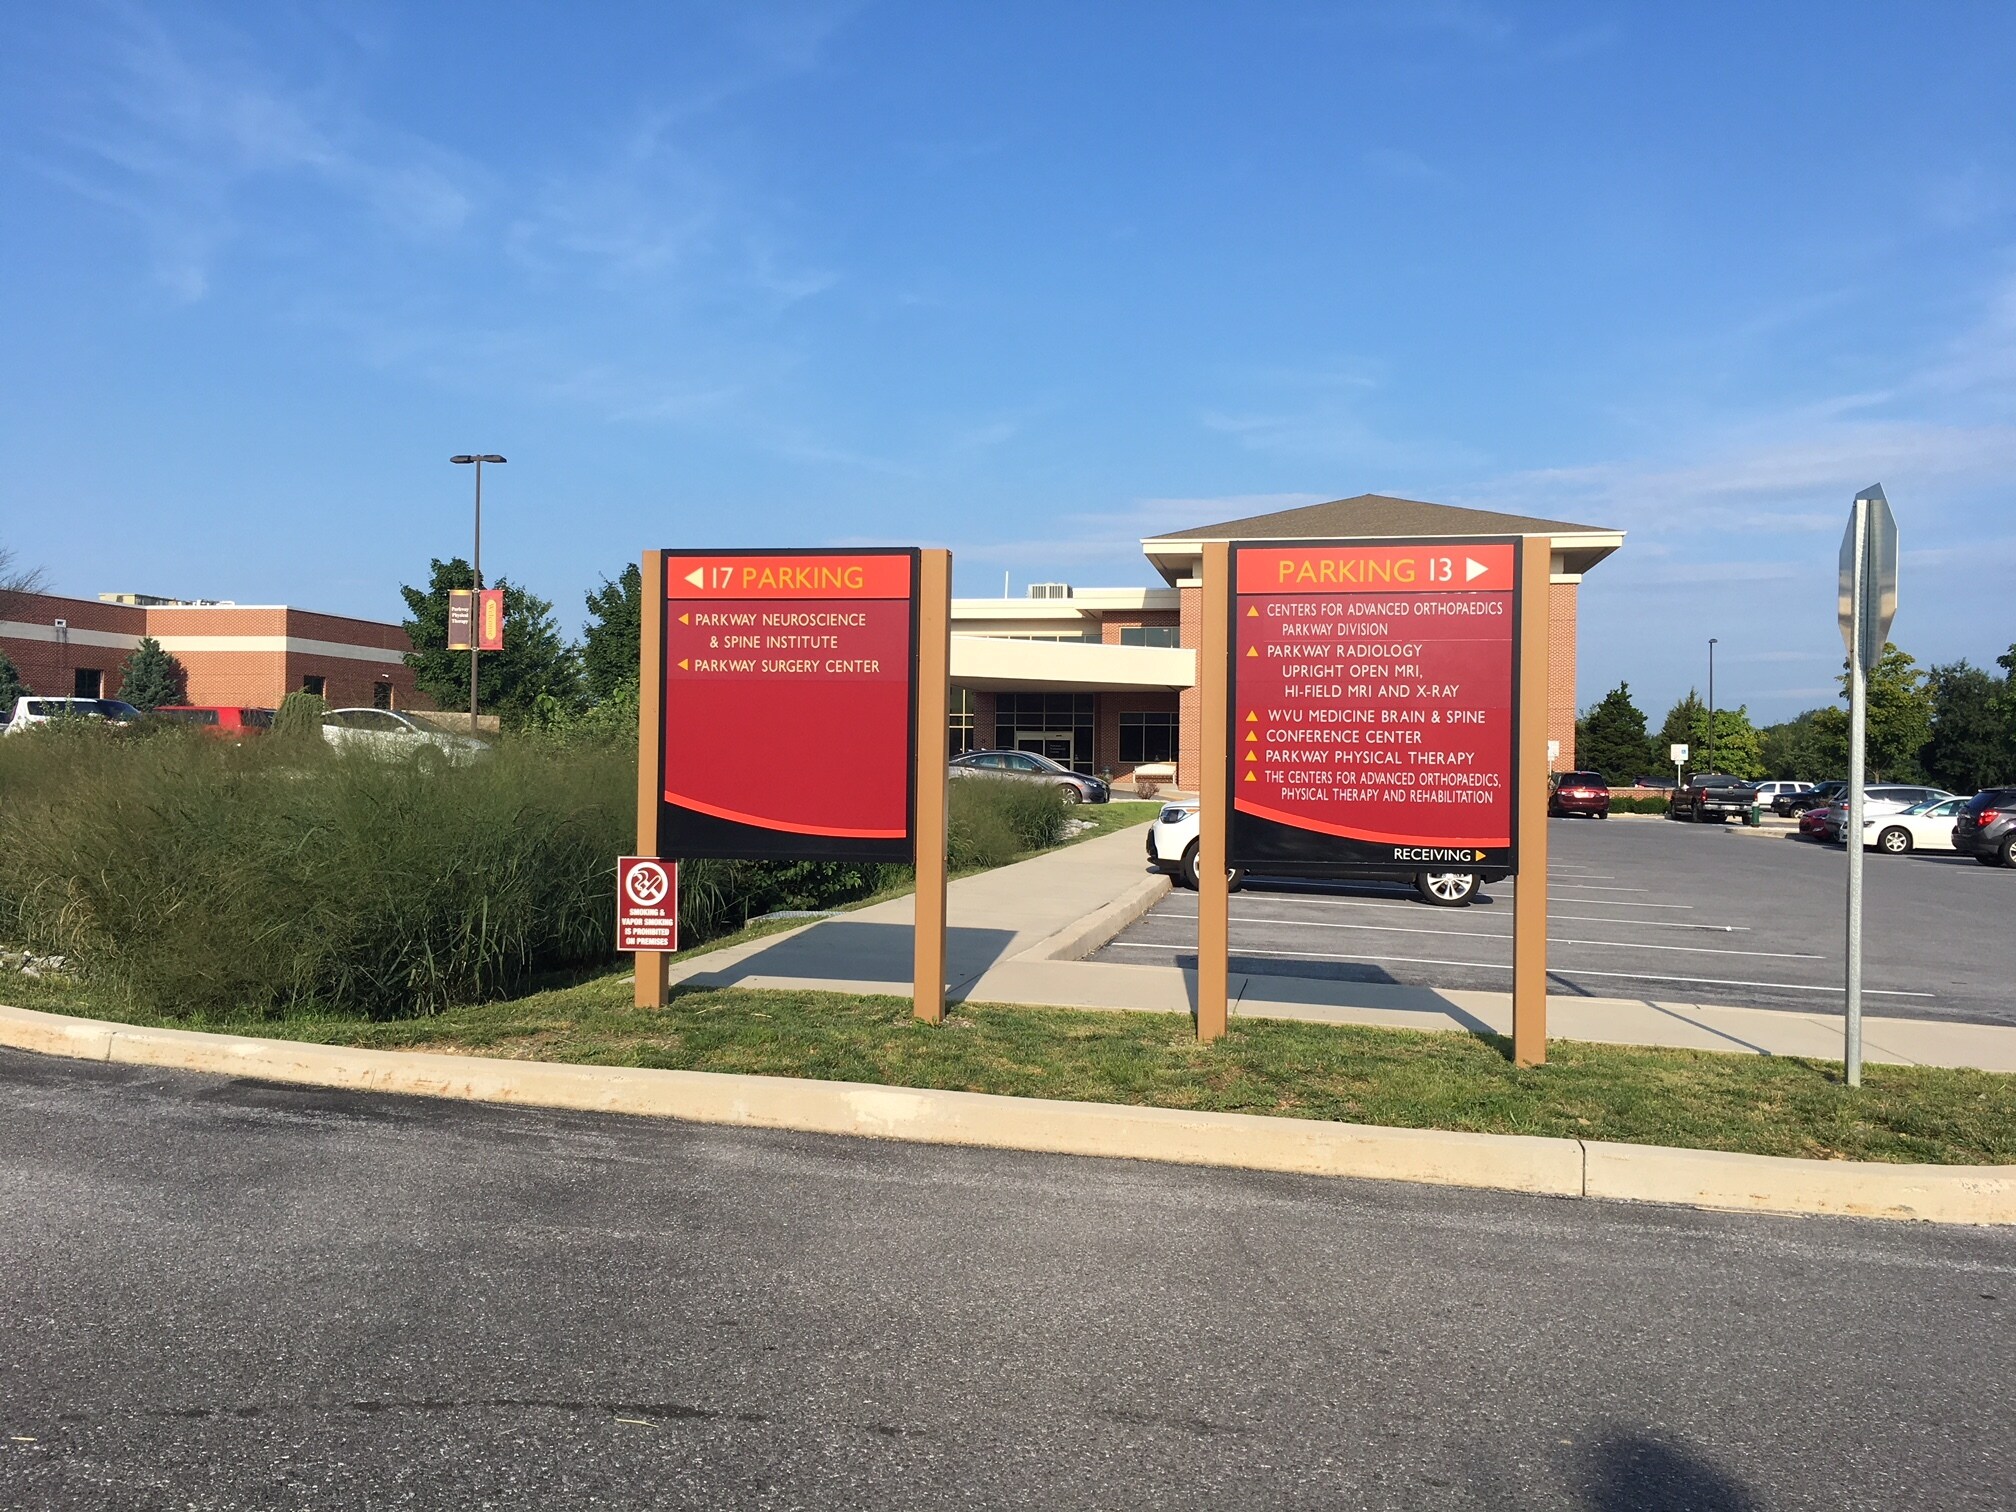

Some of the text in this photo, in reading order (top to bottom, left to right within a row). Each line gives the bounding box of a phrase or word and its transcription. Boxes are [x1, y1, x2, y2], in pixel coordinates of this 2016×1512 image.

[1279, 558, 1453, 583] PARKING 13
[712, 567, 864, 589] 17 PARKING
[1267, 602, 1503, 617] CENTERS FOR ADVANCED ORTHOPAEDICS
[695, 613, 866, 627] PARKWAY NEUROSCIENCE
[1282, 623, 1388, 636] PARKWAY DIVISION
[709, 636, 838, 649] & SPINE INSTITUTE
[1267, 644, 1423, 658] PARKWAY RADIOLOGY
[694, 660, 880, 673] PARKWAY SURGERY CENTER
[1282, 664, 1423, 679] UPRIGHT OPEN MRI,
[1285, 684, 1460, 698] HI-FIELD MRI AND X-RAY
[1268, 710, 1486, 724] WVU MEDICINE BRAIN & SPINE
[1266, 730, 1422, 744] CONFERENCE CENTER
[1265, 750, 1475, 765] PARKWAY PHYSICAL THERAPY
[1265, 770, 1502, 788] THE CENTERS FOR ADVANCED ORTHOPAEDICS,
[1281, 788, 1493, 804] PHYSICAL THERAPY AND REHABILITATION
[1394, 848, 1471, 862] RECEIVING
[629, 908, 658, 916] SMOKING
[622, 918, 673, 926] VAPOR SMOKING
[625, 937, 635, 945] ON
